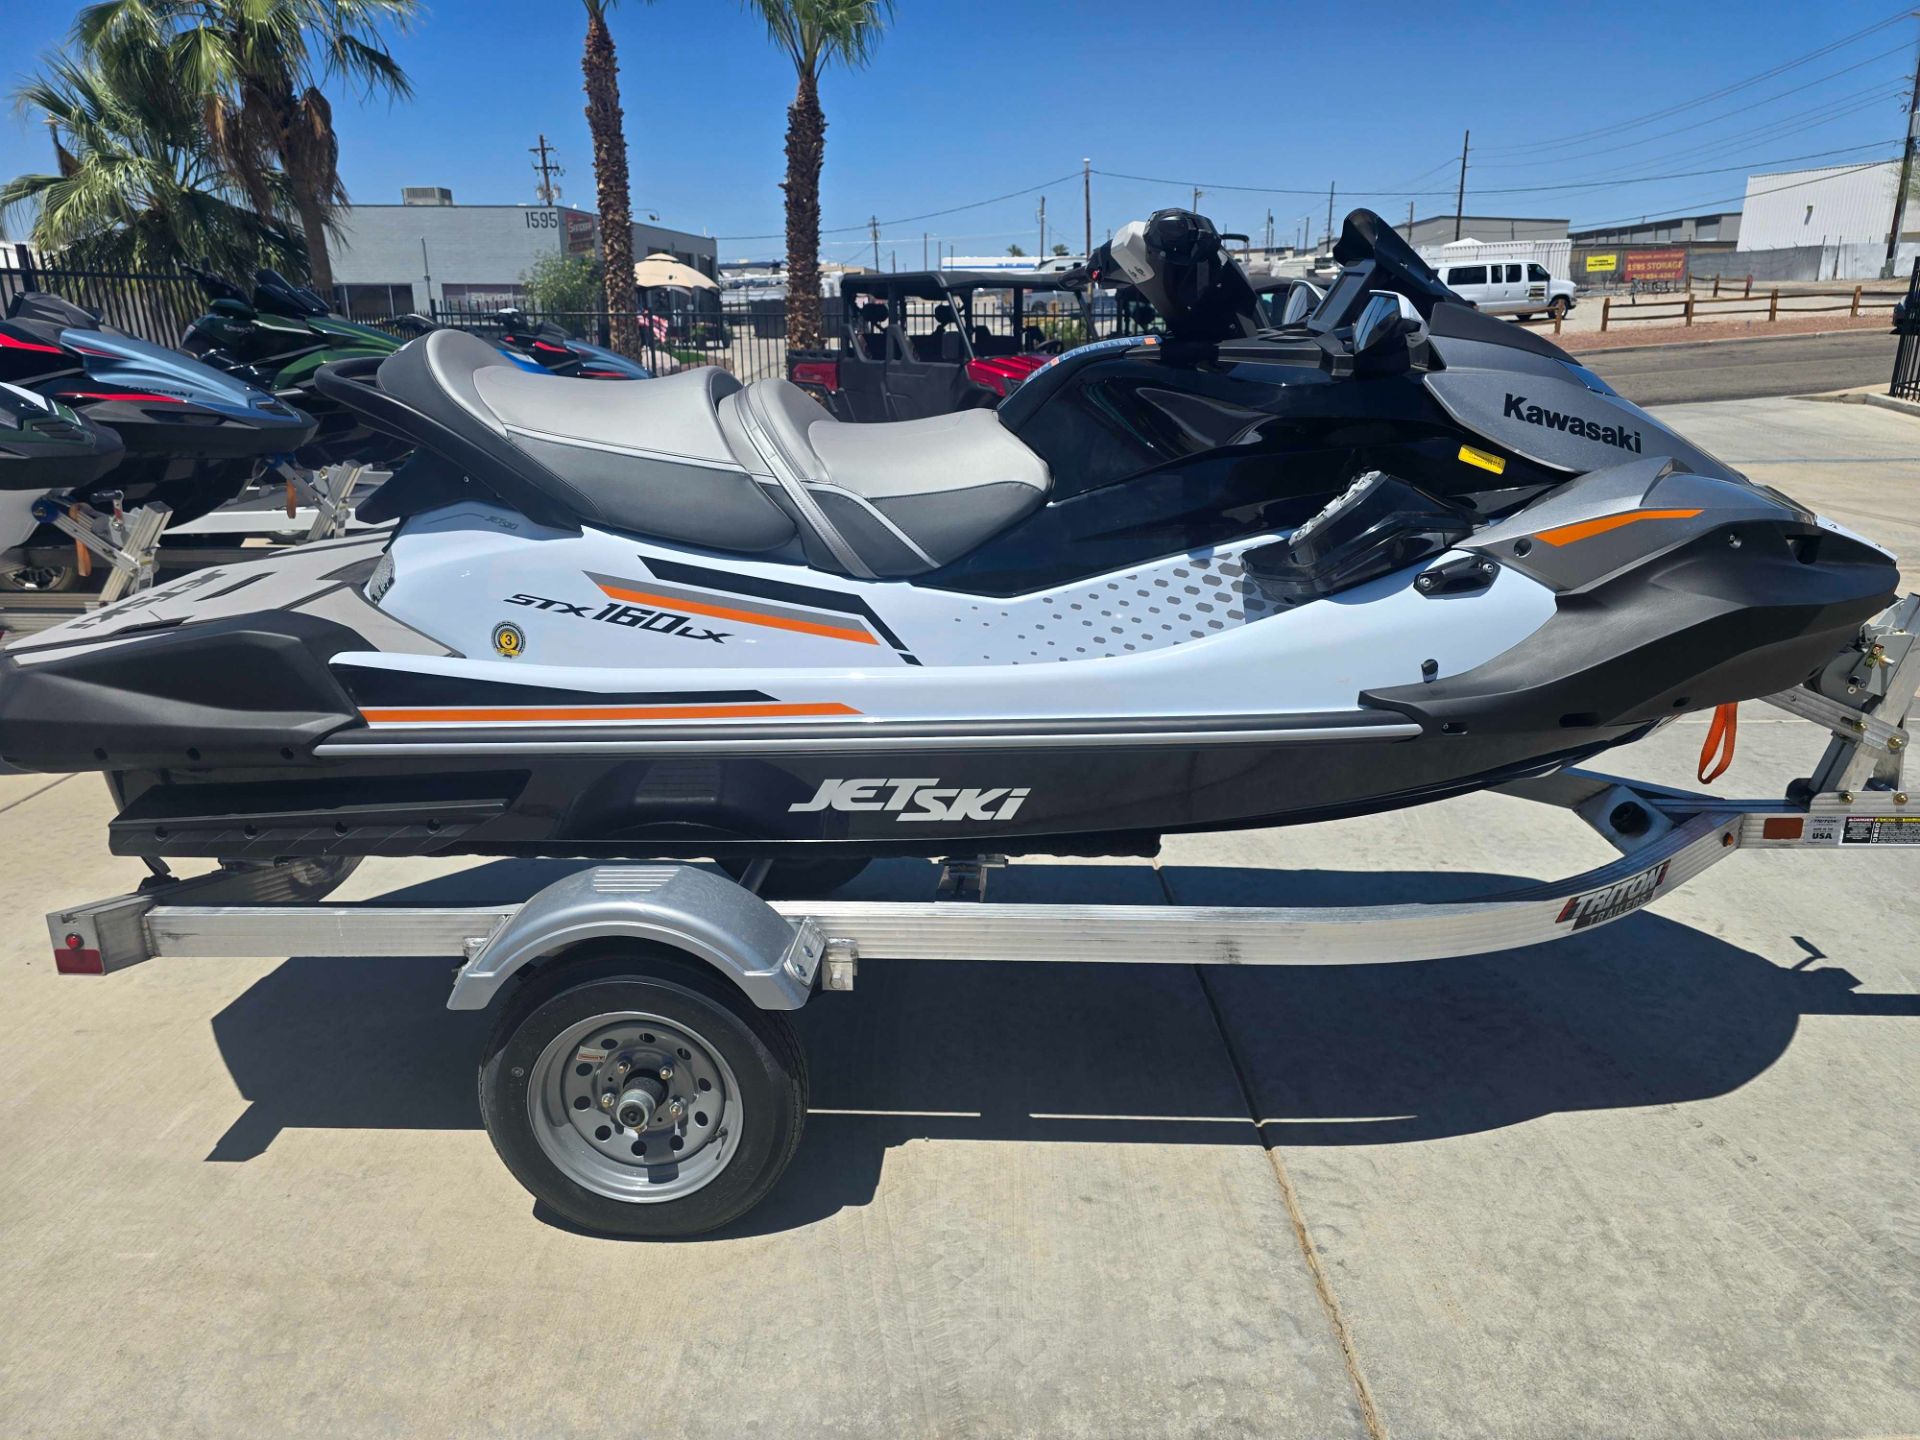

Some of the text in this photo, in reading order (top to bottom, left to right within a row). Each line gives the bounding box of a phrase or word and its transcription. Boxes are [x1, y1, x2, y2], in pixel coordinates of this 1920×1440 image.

[525, 211, 558, 229] 1595
[1647, 260, 1683, 270] STORAGE
[1503, 392, 1642, 455] Kawasaki
[504, 634, 513, 646] 3
[1812, 832, 1833, 840] USA
[1571, 864, 1664, 919] TRITON
[1589, 892, 1648, 926] TRAILERS
